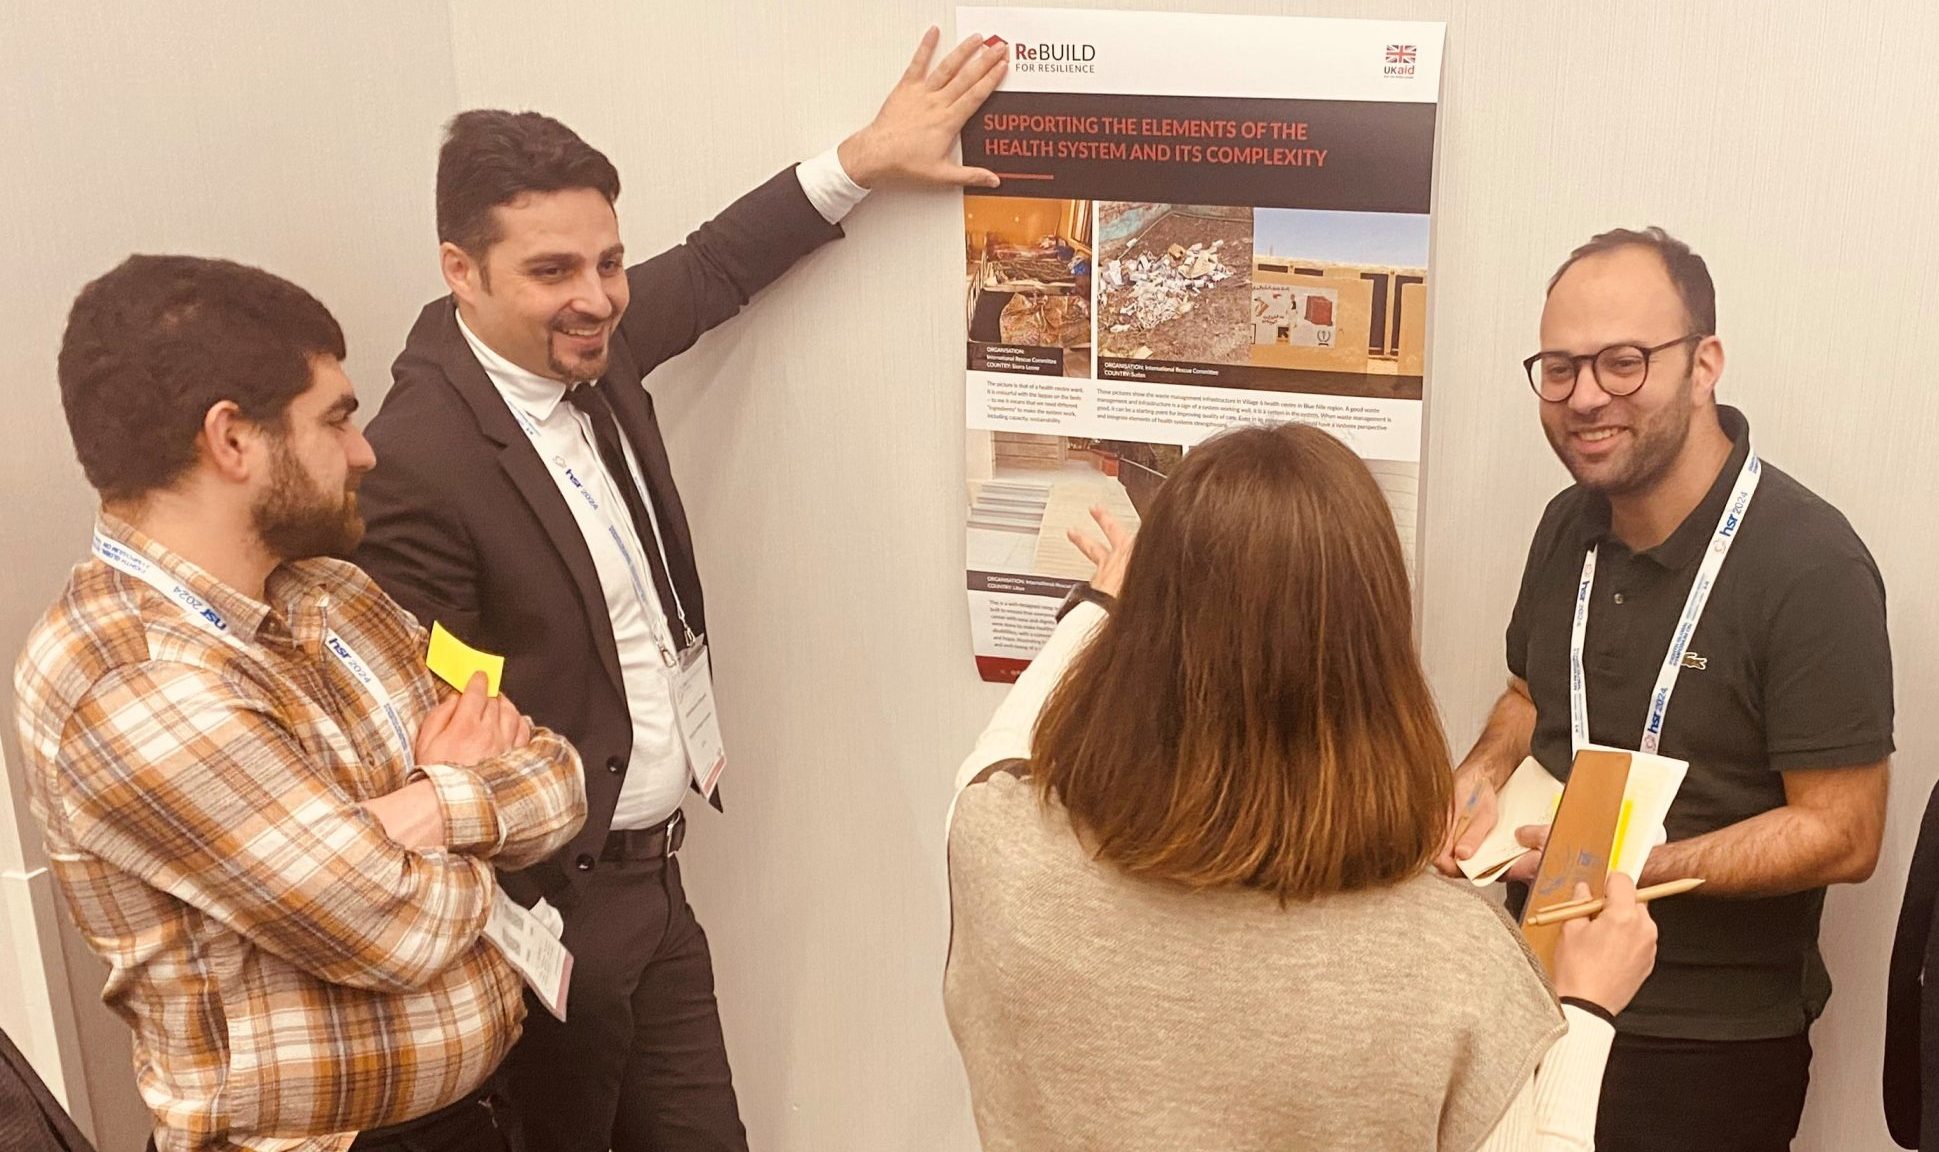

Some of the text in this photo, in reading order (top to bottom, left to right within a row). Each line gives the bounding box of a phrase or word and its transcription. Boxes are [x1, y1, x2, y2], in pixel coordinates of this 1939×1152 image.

[1016, 43, 1096, 61] ReBUILD
[1015, 64, 1095, 73] FOR RESILIENCE
[984, 114, 1308, 140] SUPPORTING THE ELEMENTS OF THE
[985, 139, 1327, 167] HEALTH SYSTEM AND ITS COMPLEXITY
[566, 469, 583, 488] hsr
[1719, 491, 1748, 537] hsr 2024
[173, 586, 202, 610] 2024
[1580, 581, 1590, 602] hsr
[329, 638, 371, 683] hsr 2024
[1647, 687, 1668, 734] hsr 2024
